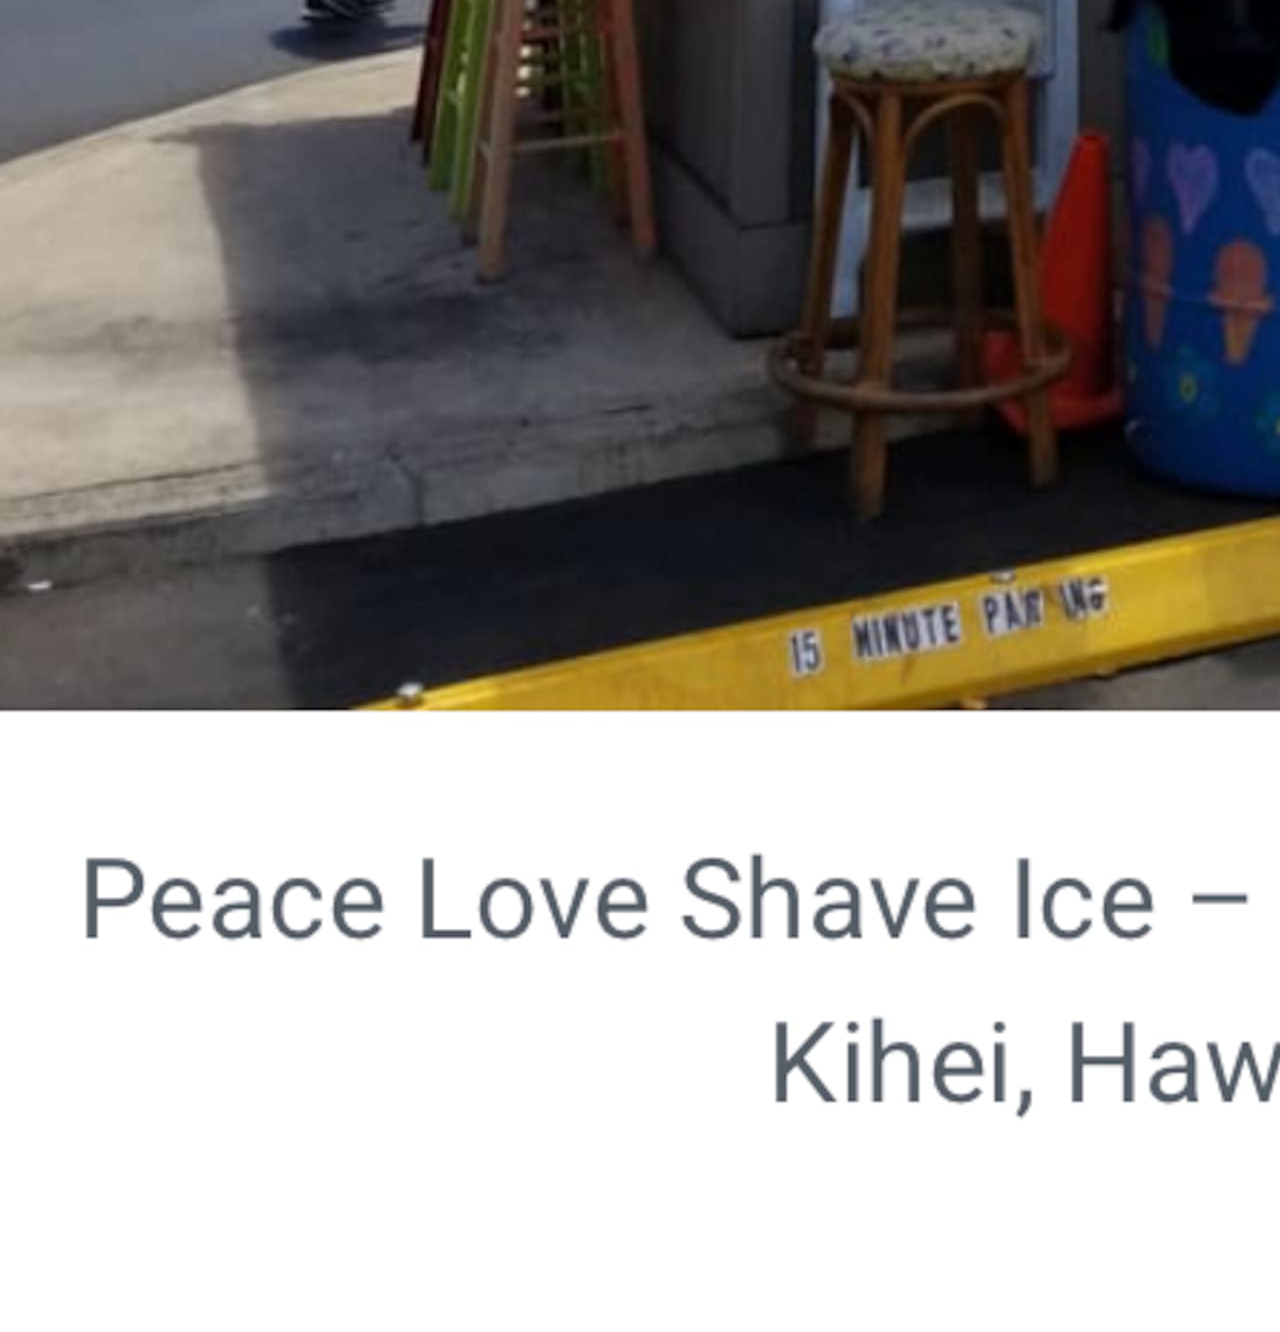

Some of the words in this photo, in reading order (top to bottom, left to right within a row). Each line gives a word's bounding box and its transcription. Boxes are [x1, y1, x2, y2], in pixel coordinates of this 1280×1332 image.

[789, 631, 821, 674] 15
[851, 603, 960, 660] MINUTE
[982, 575, 1106, 635] PARING
